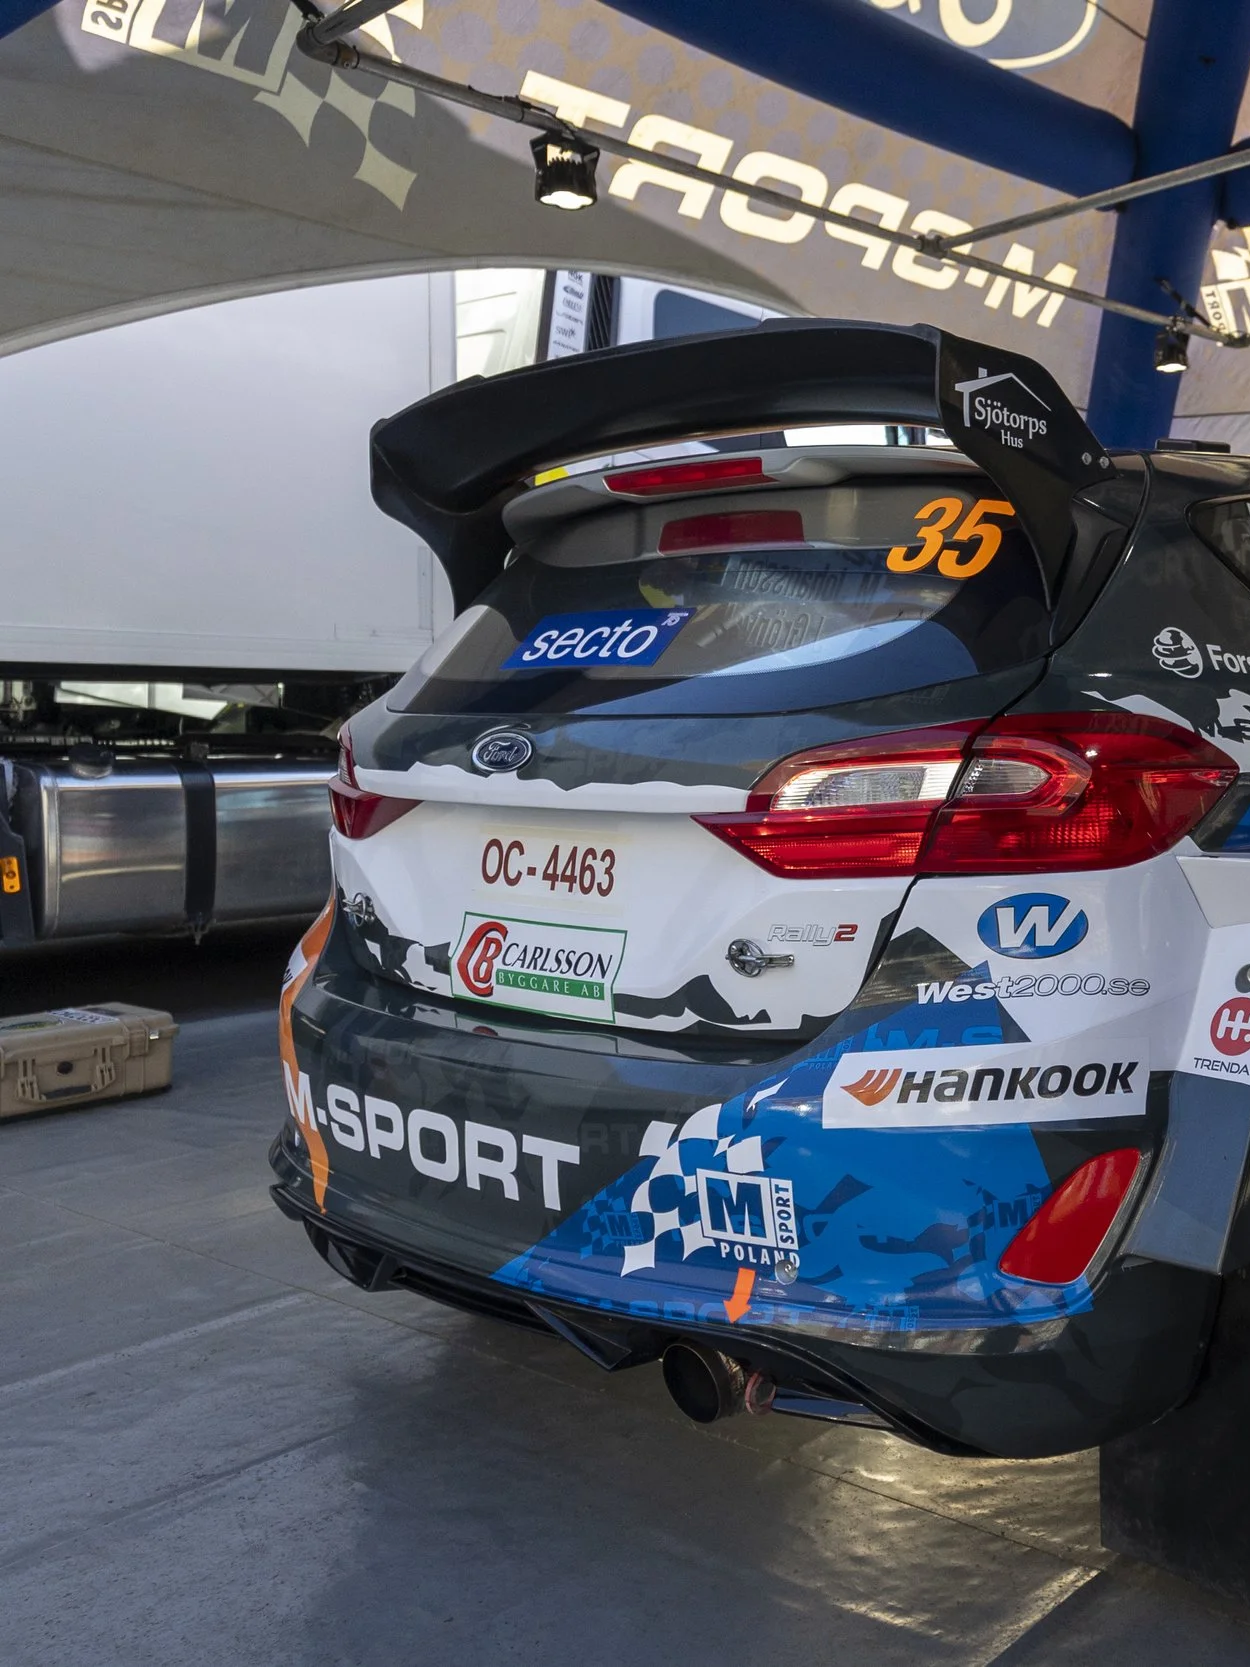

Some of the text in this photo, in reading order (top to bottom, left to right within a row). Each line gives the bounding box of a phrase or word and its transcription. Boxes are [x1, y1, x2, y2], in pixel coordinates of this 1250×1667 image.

[974, 397, 1047, 439] Sjötorps
[1000, 429, 1024, 448] Hus
[886, 497, 1016, 578] 35
[522, 619, 658, 661] secto
[483, 741, 518, 763] Ford
[481, 838, 616, 897] OC-4463
[767, 923, 858, 946] Rally2
[996, 899, 1083, 949] W
[501, 942, 613, 979] CARLSSON
[498, 971, 601, 998] BYGGARE AB
[917, 972, 1151, 1005] West2000.se
[282, 1060, 580, 1212] M-SPORT
[704, 1176, 768, 1239] M
[773, 1184, 795, 1245] SPORT
[720, 1242, 800, 1268] POLAND
